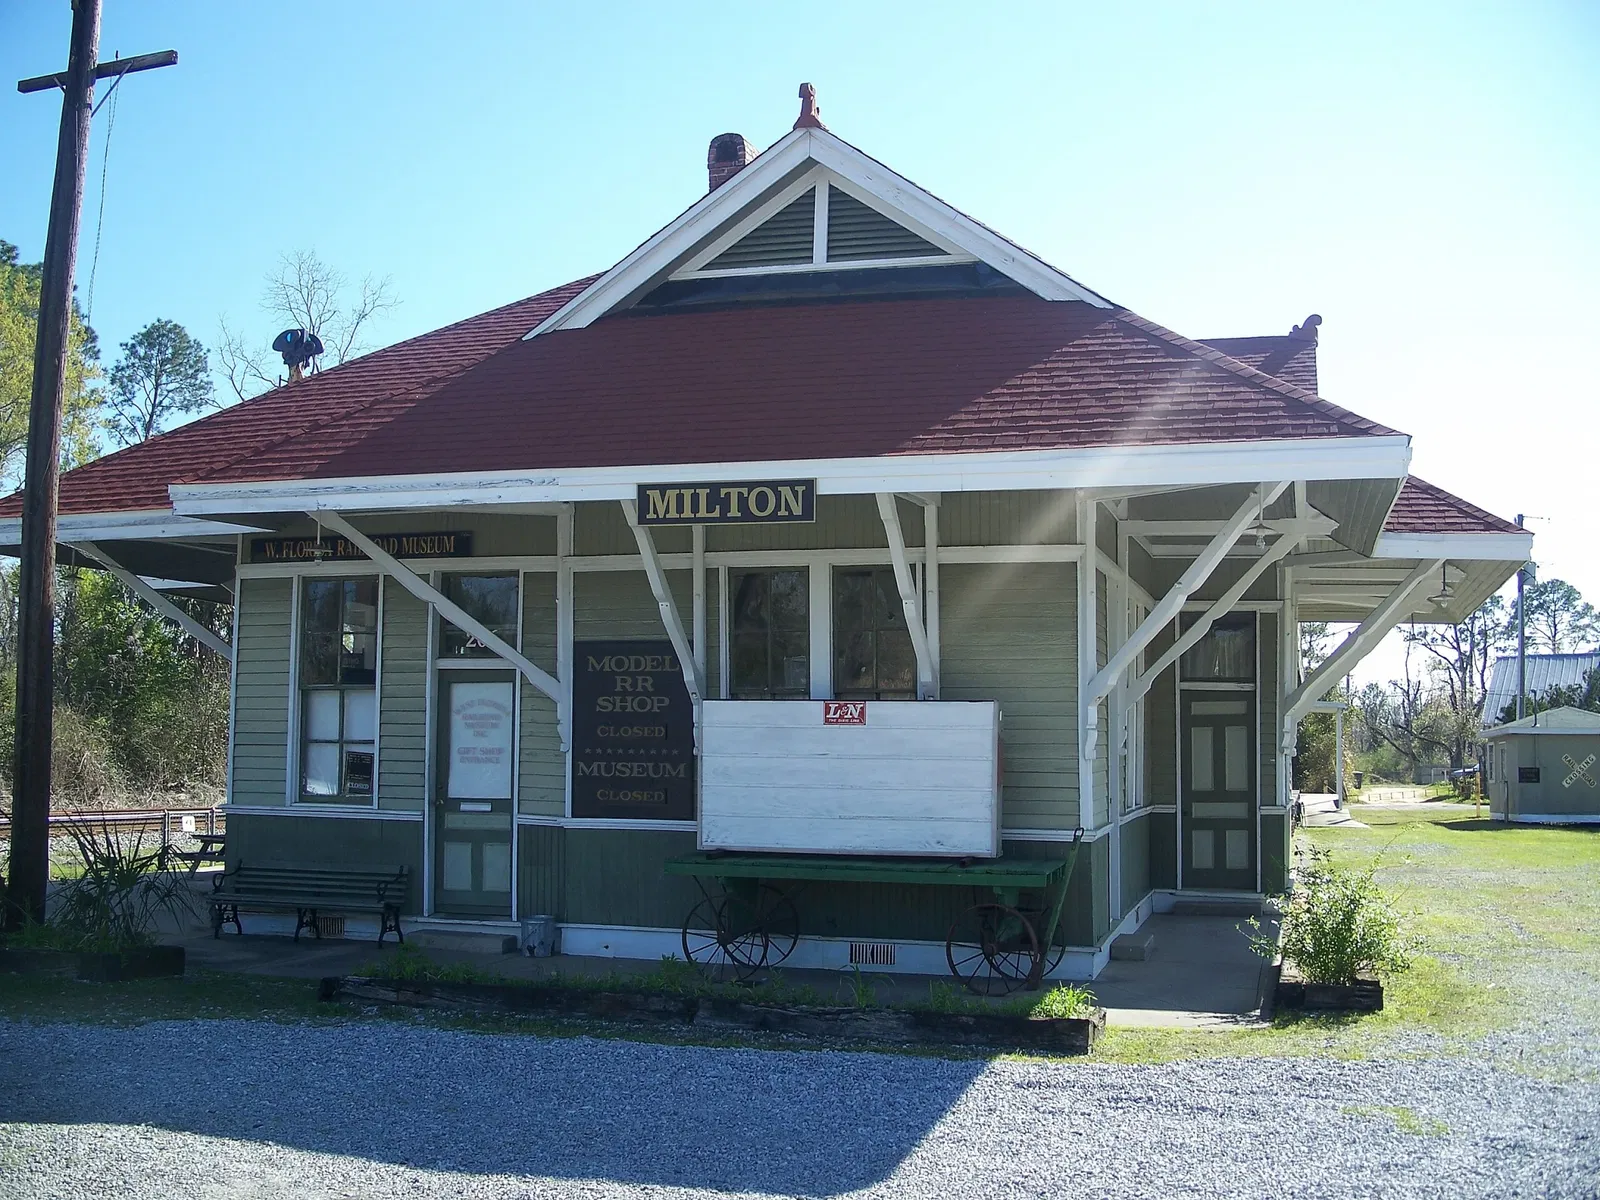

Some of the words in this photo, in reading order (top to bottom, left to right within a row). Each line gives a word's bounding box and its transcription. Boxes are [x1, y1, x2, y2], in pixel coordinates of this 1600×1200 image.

[646, 486, 806, 519] MILTON
[265, 542, 279, 558] W.
[337, 537, 398, 556] RAILOAD
[402, 535, 455, 554] MUSEUM
[587, 656, 680, 672] MODEL
[614, 676, 654, 691] RR
[596, 696, 669, 712] SHOP
[826, 704, 864, 718] L&N
[597, 725, 665, 737] CLOSED
[1562, 755, 1576, 769] RAIL
[577, 762, 687, 778] MUSEUM
[1564, 756, 1594, 785] CROSSING
[1581, 772, 1596, 787] ROAD
[597, 789, 665, 801] CLOSED
